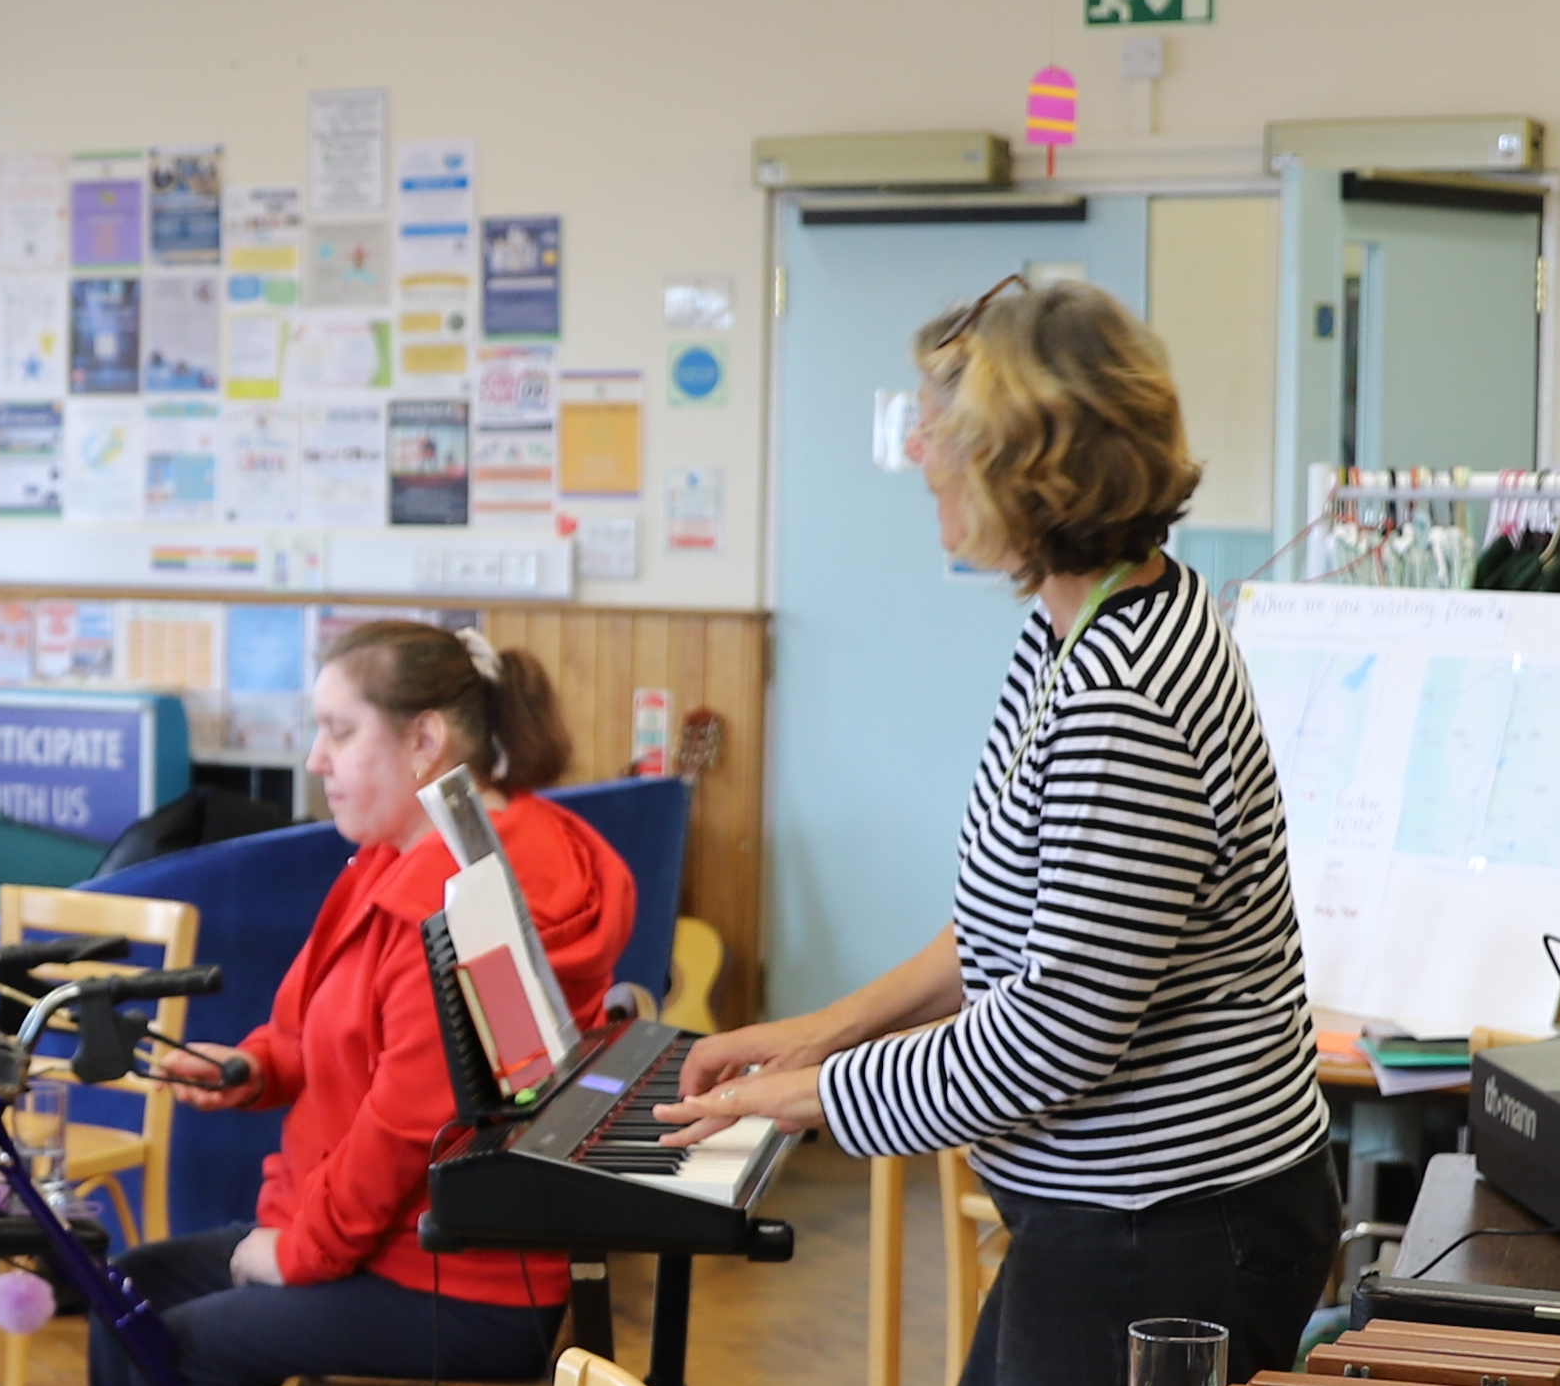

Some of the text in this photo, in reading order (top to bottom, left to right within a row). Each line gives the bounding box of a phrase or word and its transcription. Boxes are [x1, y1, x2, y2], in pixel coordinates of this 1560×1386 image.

[1251, 592, 1296, 616] Where
[1301, 598, 1324, 613] are
[1327, 597, 1360, 629] you
[1370, 598, 1435, 628] visiting
[51, 785, 92, 829] US
